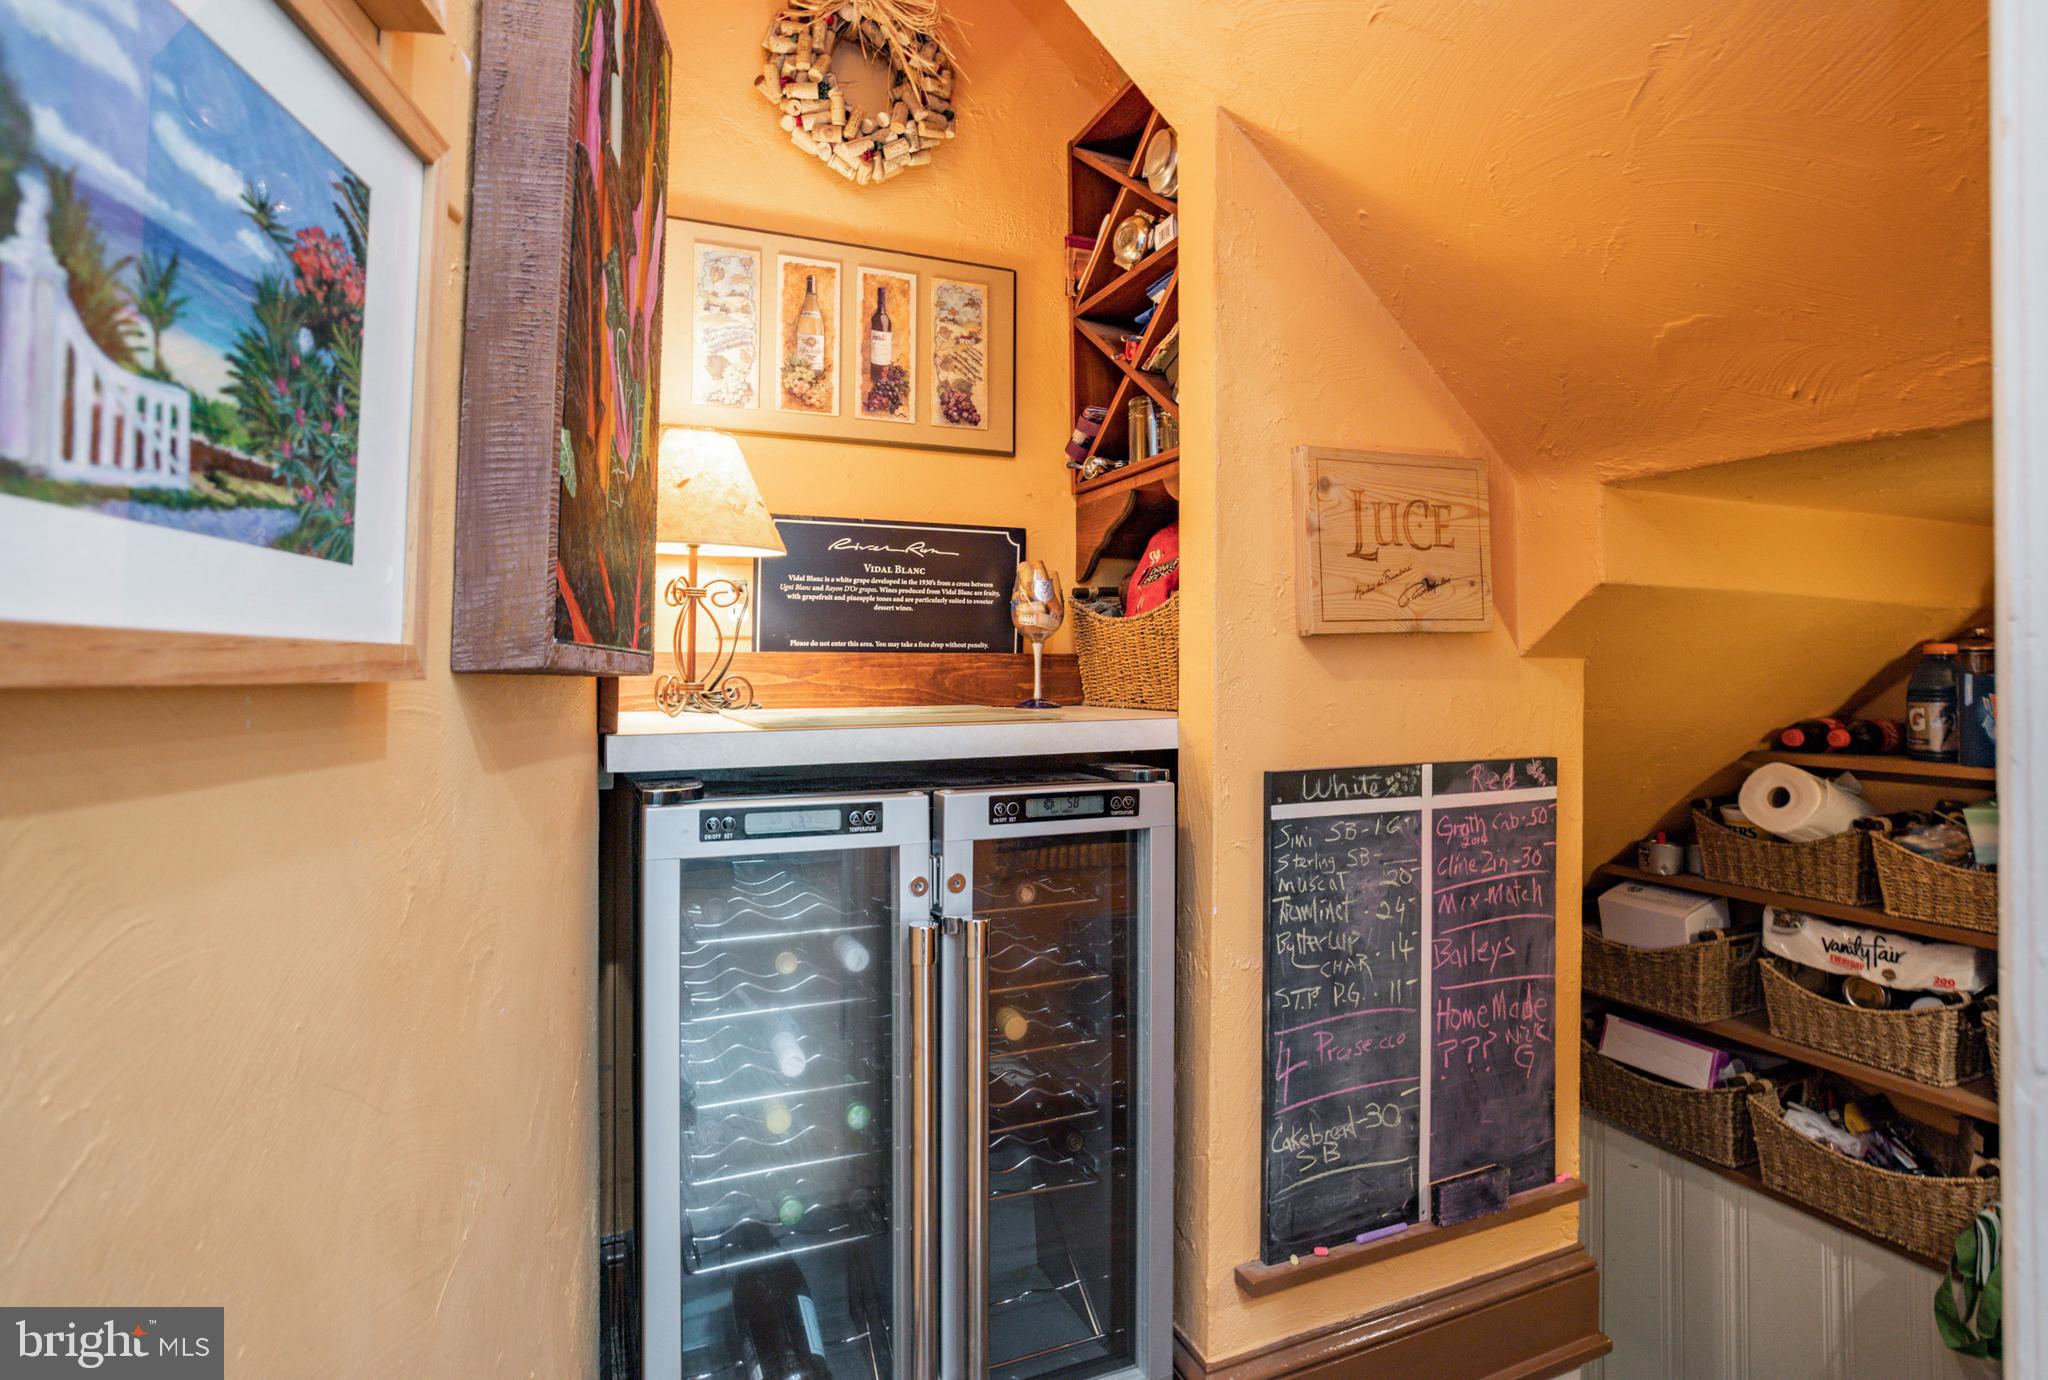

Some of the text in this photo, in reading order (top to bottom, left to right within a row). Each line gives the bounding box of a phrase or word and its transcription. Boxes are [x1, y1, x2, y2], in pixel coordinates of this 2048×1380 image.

[1347, 489, 1455, 562] LUCE
[788, 574, 805, 582] Vidal
[870, 577, 900, 586] developed
[970, 580, 993, 588] between
[780, 583, 794, 591] Ugni
[802, 593, 833, 601] grapefruit
[846, 594, 875, 602] pineapple
[789, 639, 809, 647] Please
[930, 641, 945, 649] drop
[1466, 762, 1517, 793] Red
[1302, 773, 1382, 800] White
[849, 825, 877, 833] TEMPERATURE
[704, 832, 733, 841] ON/OFF SET
